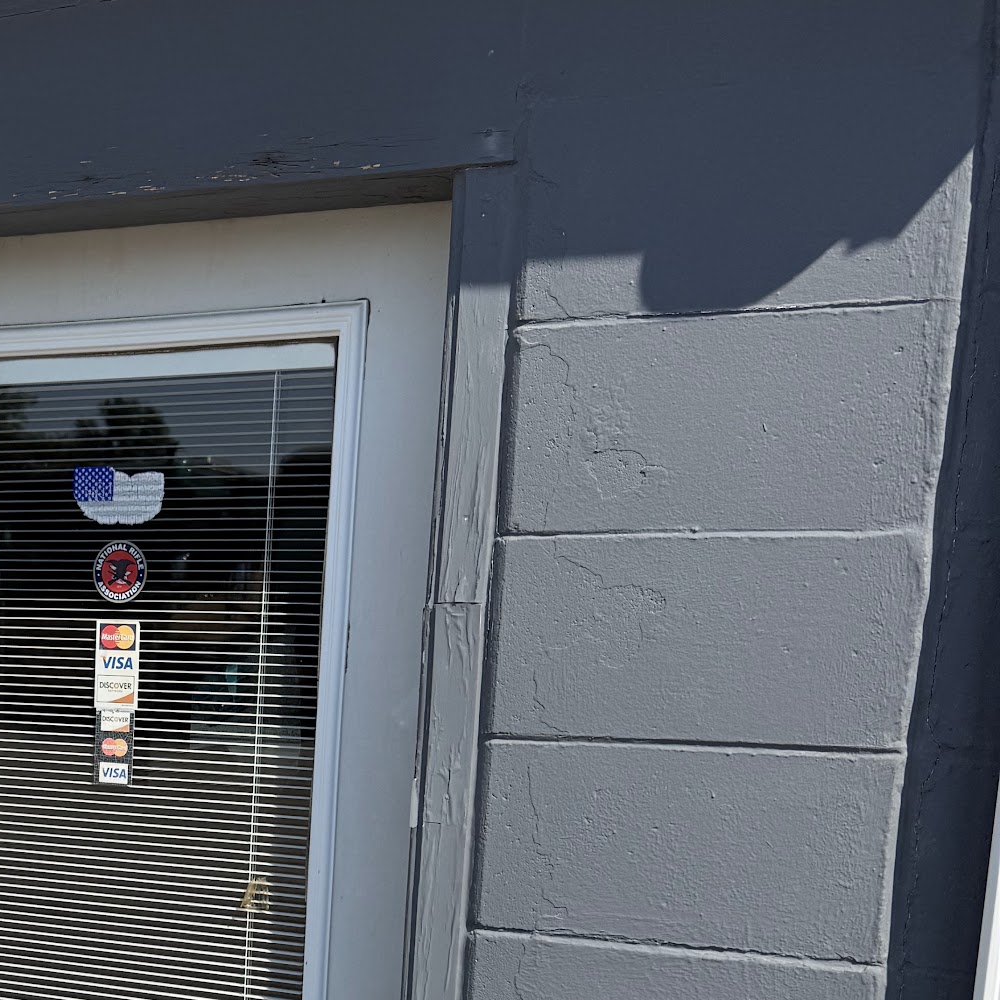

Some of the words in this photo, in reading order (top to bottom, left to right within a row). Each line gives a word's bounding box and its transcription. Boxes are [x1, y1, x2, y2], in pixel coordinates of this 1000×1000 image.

[96, 544, 127, 570] NATIONAL
[129, 547, 144, 570] RIFLE
[98, 581, 141, 599] ASSOCIATION
[102, 656, 133, 670] VISA
[99, 681, 132, 690] DISCOVER
[102, 715, 129, 723] DISCOVER
[102, 767, 126, 778] VISA
